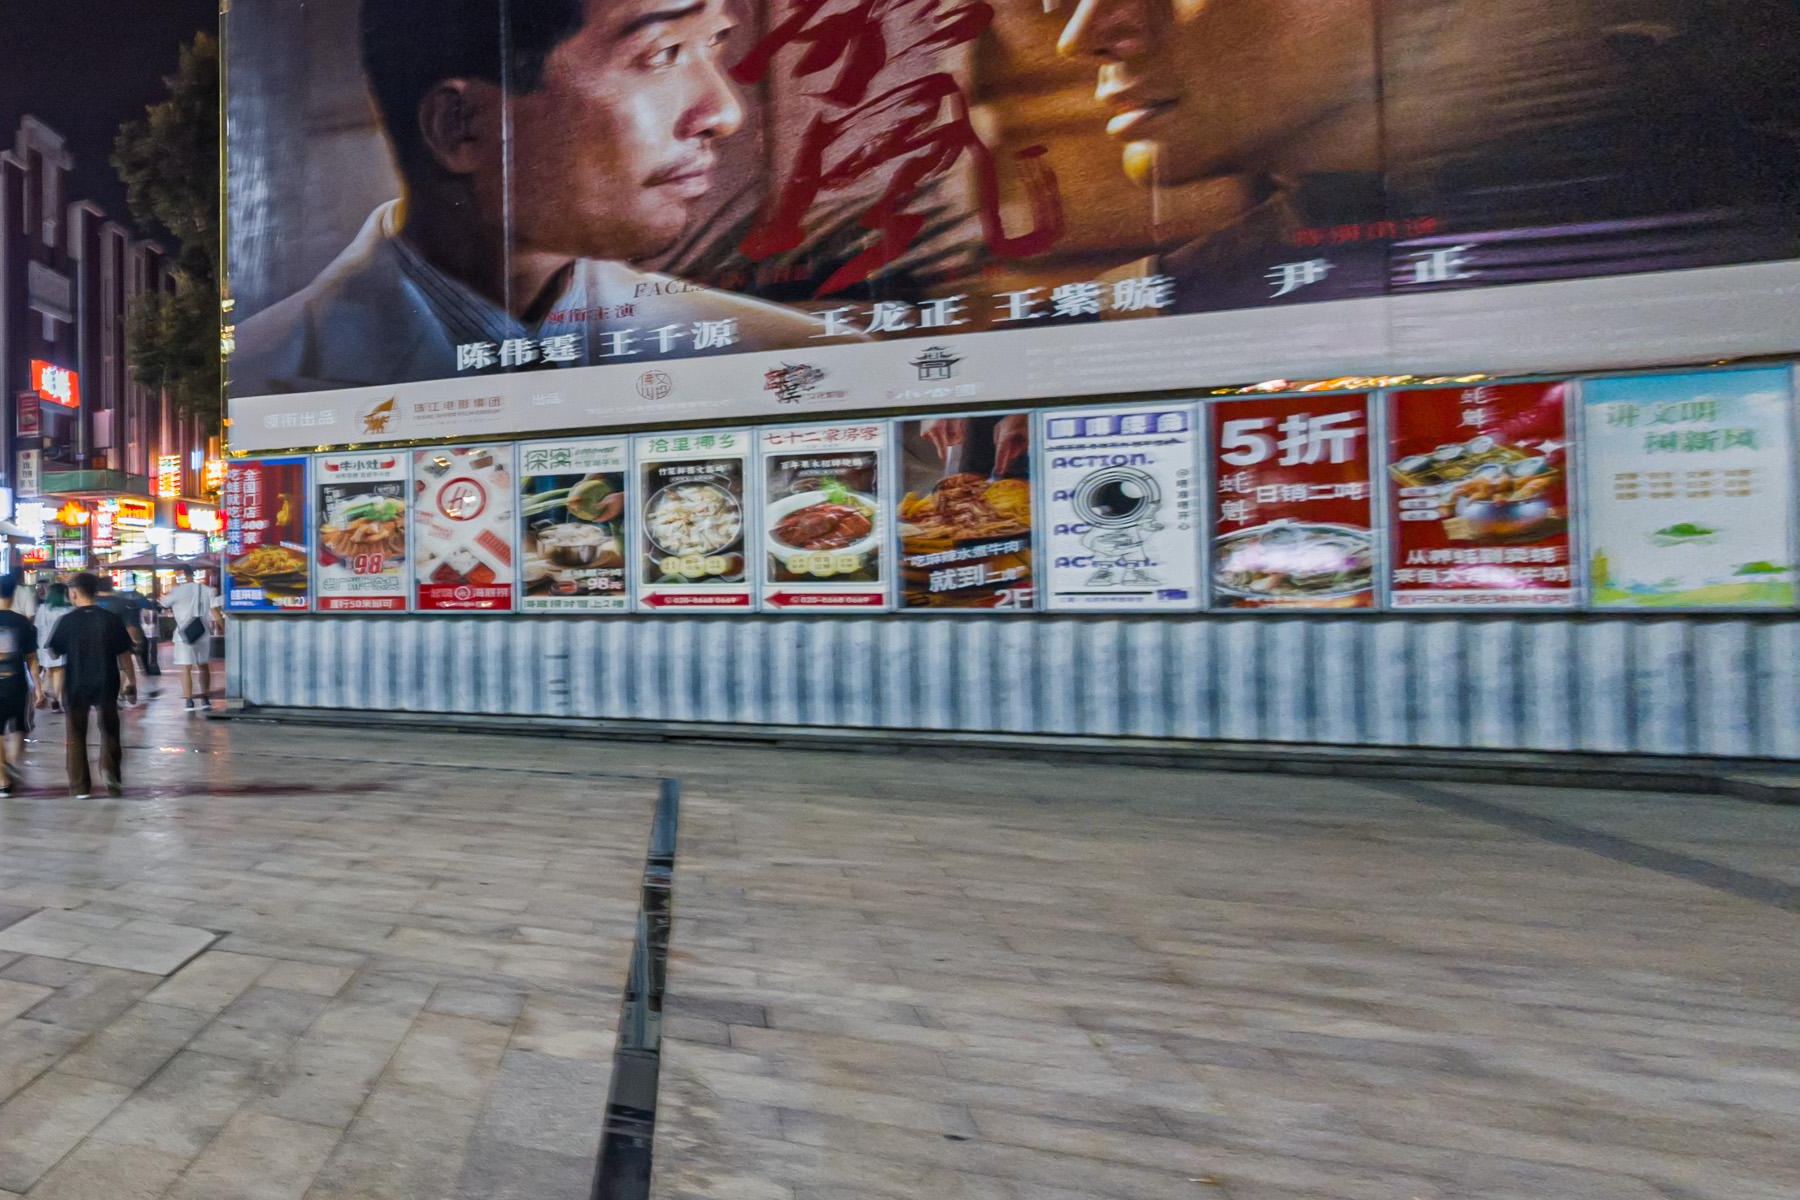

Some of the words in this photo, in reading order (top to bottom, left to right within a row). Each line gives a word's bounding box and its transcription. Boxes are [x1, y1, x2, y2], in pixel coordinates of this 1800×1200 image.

[456, 333, 584, 371] 陈伟霆
[599, 317, 739, 358] 王千源
[809, 294, 971, 339] 王龙正
[1264, 243, 1481, 298] 尹正
[413, 395, 502, 413] 珠江电影集团
[1220, 410, 1366, 467] 5折
[353, 552, 384, 575] 98
[993, 587, 1032, 609] 2F
